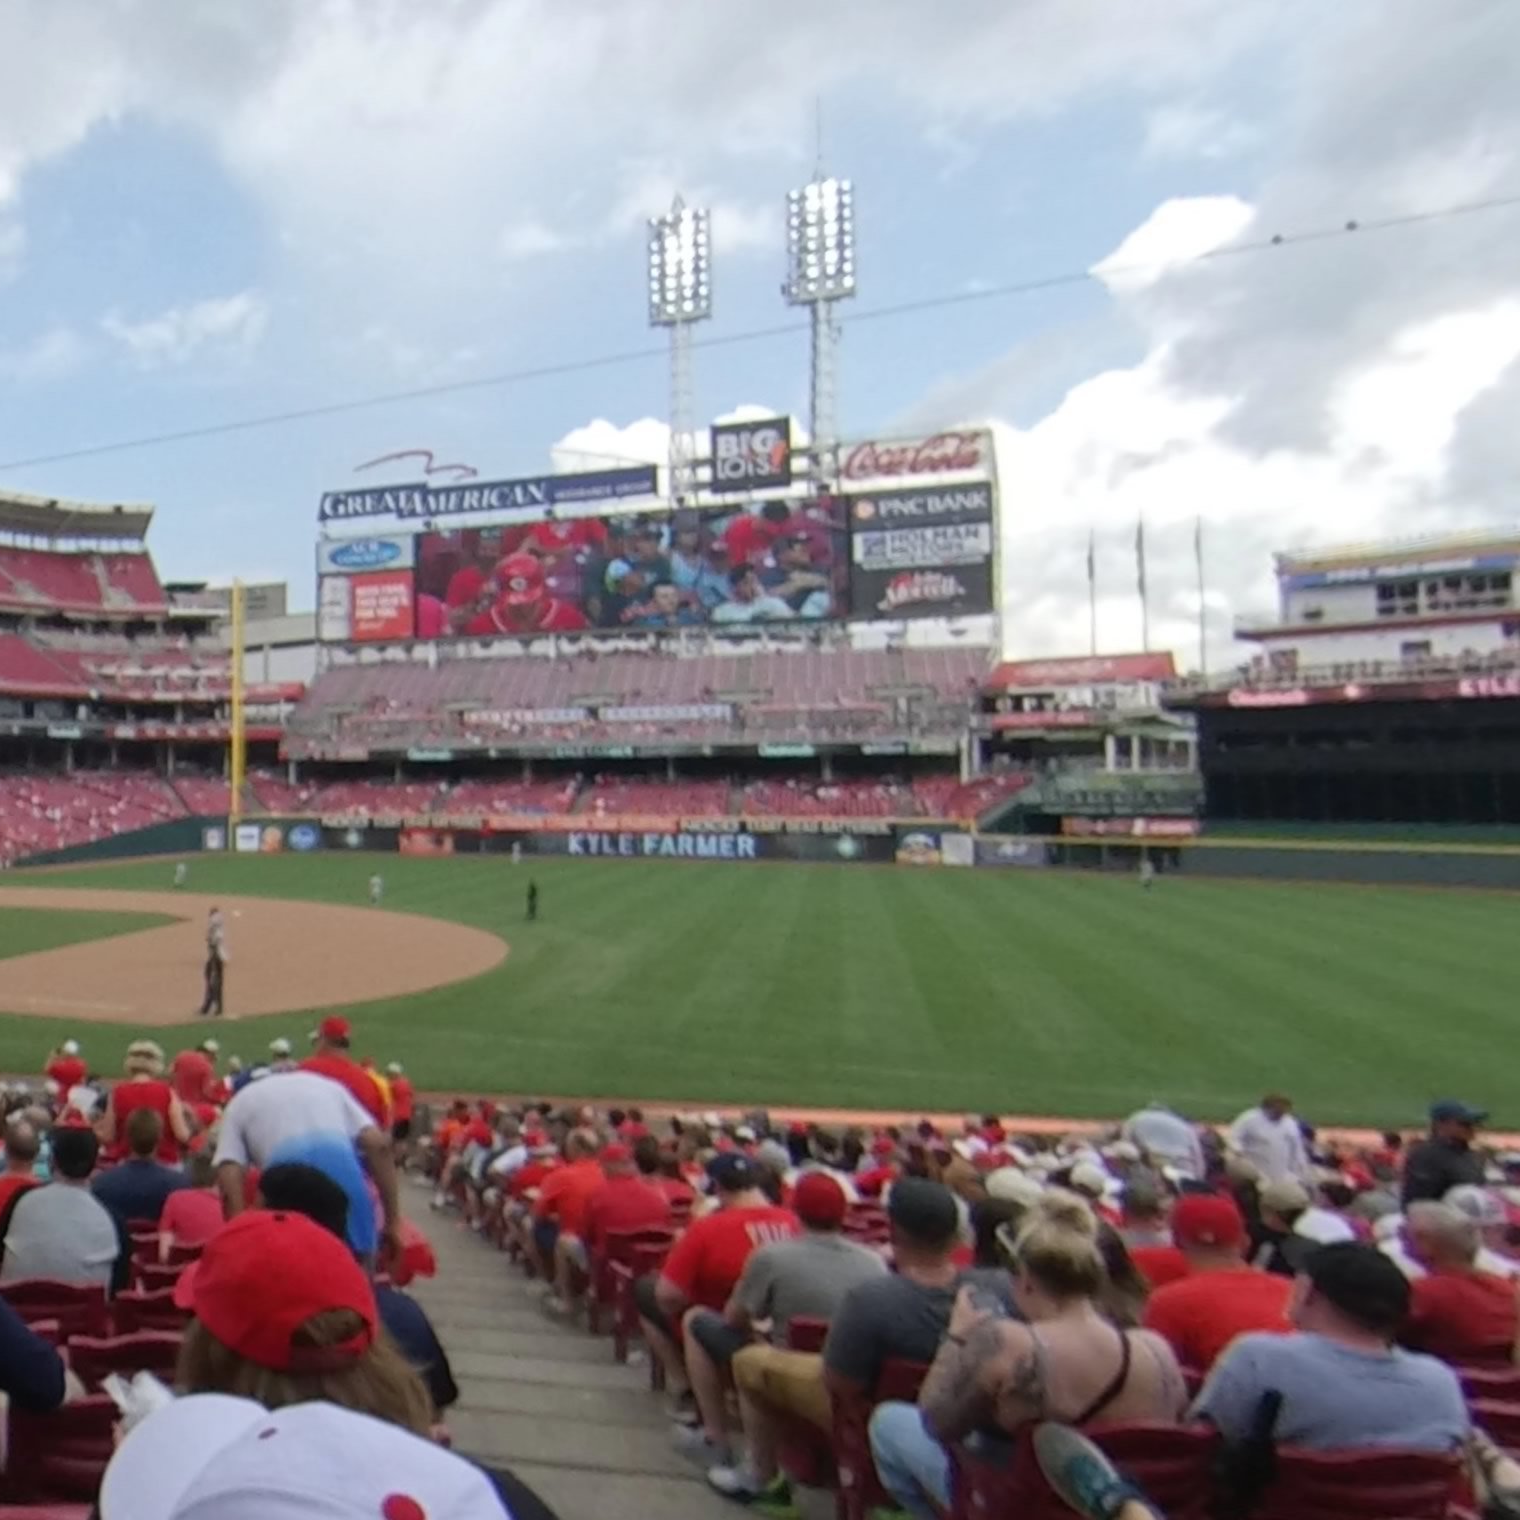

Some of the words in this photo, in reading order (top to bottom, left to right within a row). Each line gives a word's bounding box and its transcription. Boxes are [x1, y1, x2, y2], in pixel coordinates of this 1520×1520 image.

[716, 429, 780, 457] BIG
[878, 498, 924, 517] PNC
[926, 490, 988, 514] BANK
[568, 832, 634, 857] KYLE
[643, 832, 756, 858] FARMER
